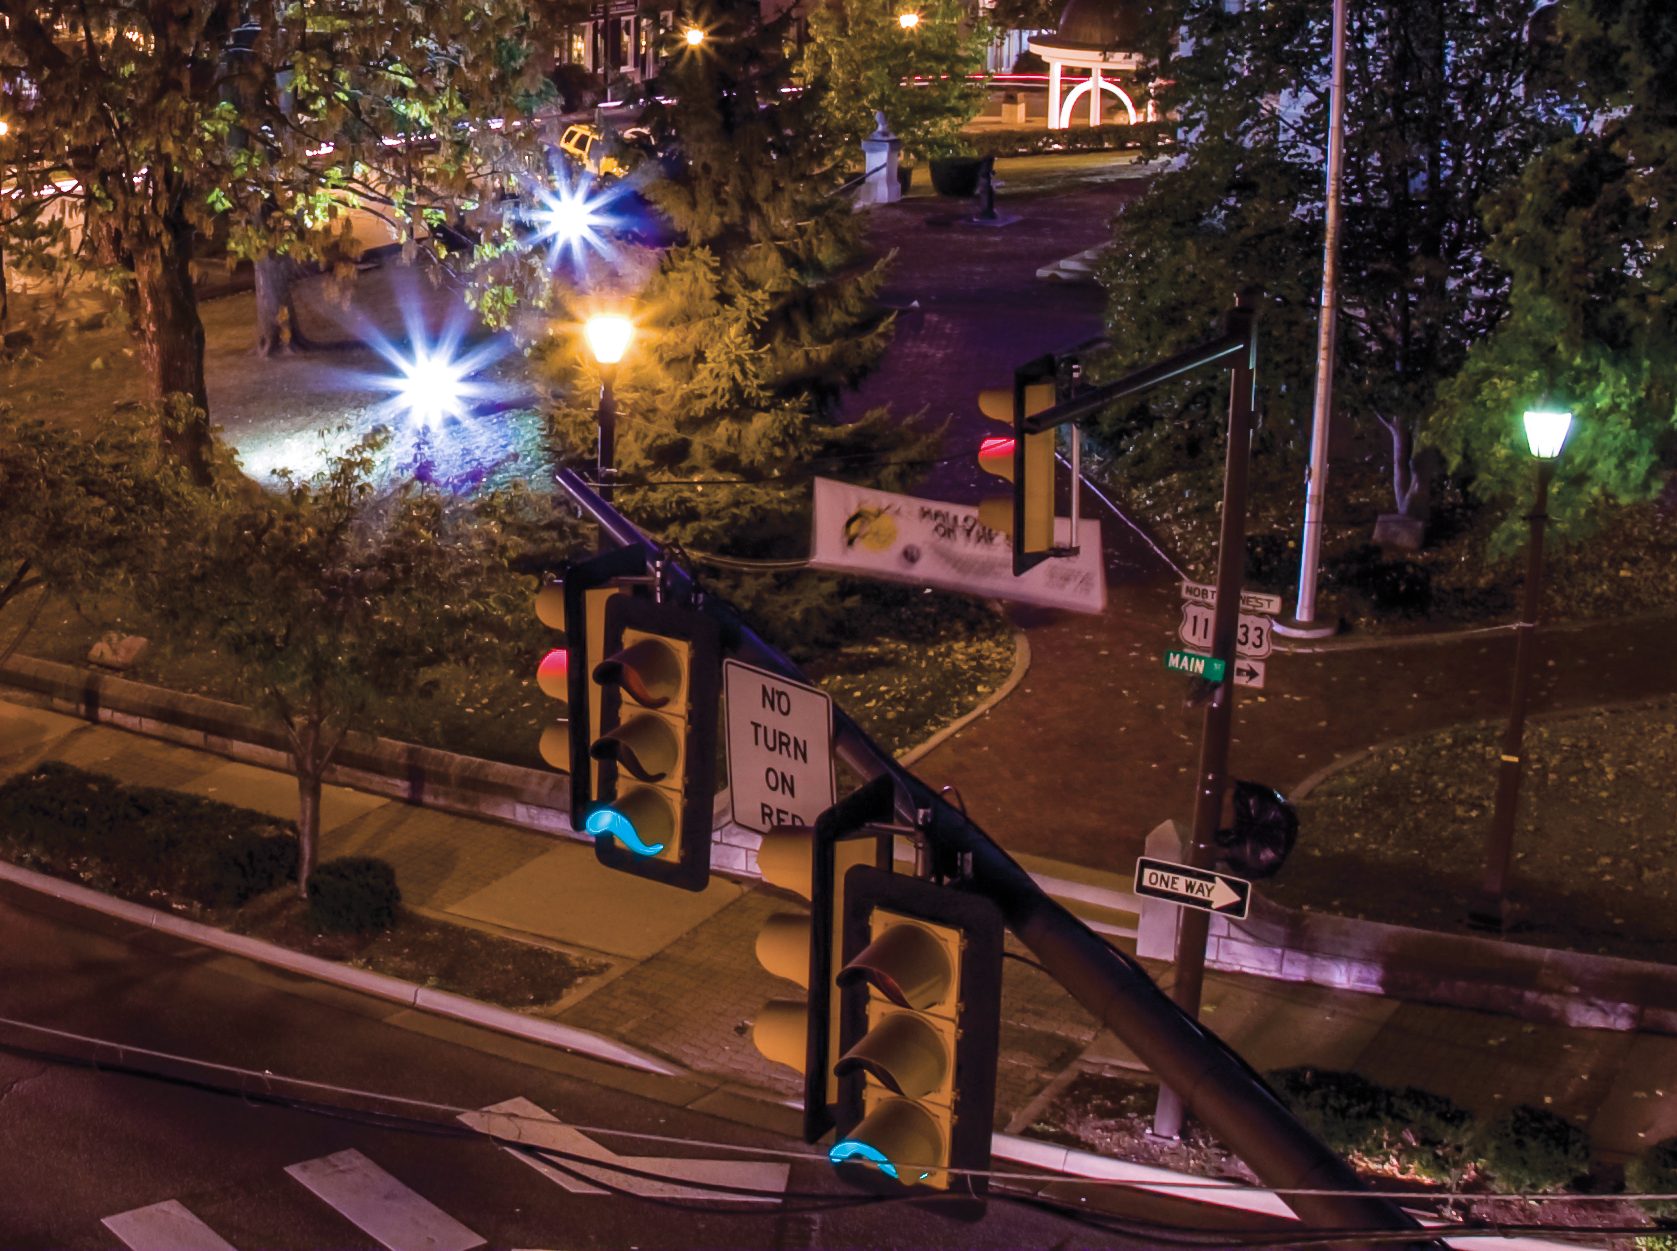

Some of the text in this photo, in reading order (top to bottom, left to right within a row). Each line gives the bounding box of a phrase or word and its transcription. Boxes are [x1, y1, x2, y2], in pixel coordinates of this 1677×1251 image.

[919, 506, 980, 531] HALLO
[1185, 586, 1217, 600] NORT
[1192, 615, 1209, 639] 11
[1237, 623, 1264, 648] 33
[1168, 652, 1205, 674] MAIN
[761, 684, 791, 716] NO
[750, 720, 808, 764] TURN
[765, 767, 795, 799] ON
[1148, 871, 1215, 898] ONE WAY
